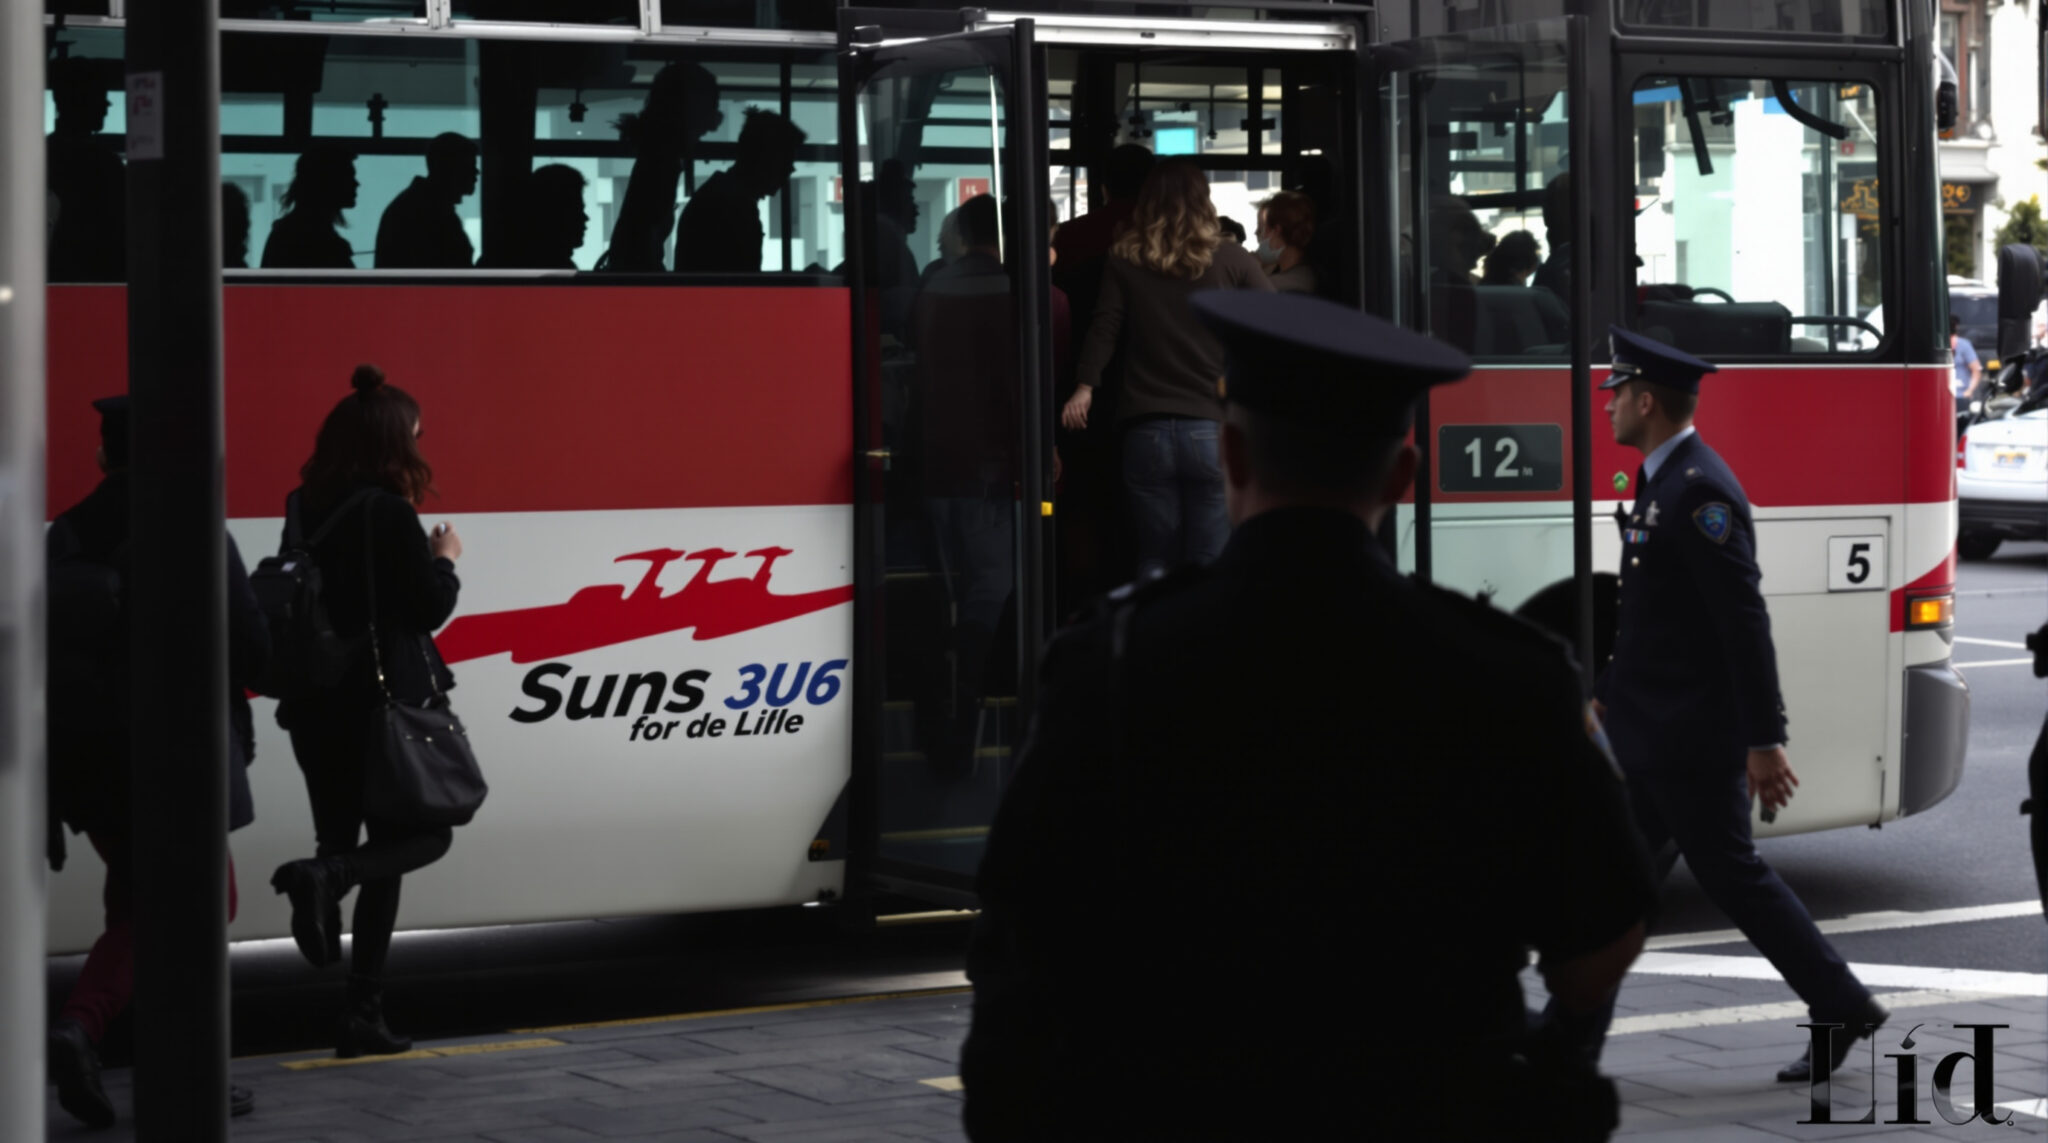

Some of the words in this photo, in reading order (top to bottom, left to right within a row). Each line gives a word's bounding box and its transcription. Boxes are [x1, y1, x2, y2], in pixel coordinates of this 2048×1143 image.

[1464, 436, 1519, 478] 12
[1846, 543, 1871, 584] 5
[508, 662, 711, 723] Suns
[723, 659, 849, 710] 3U6
[629, 715, 680, 741] for
[686, 712, 727, 739] de
